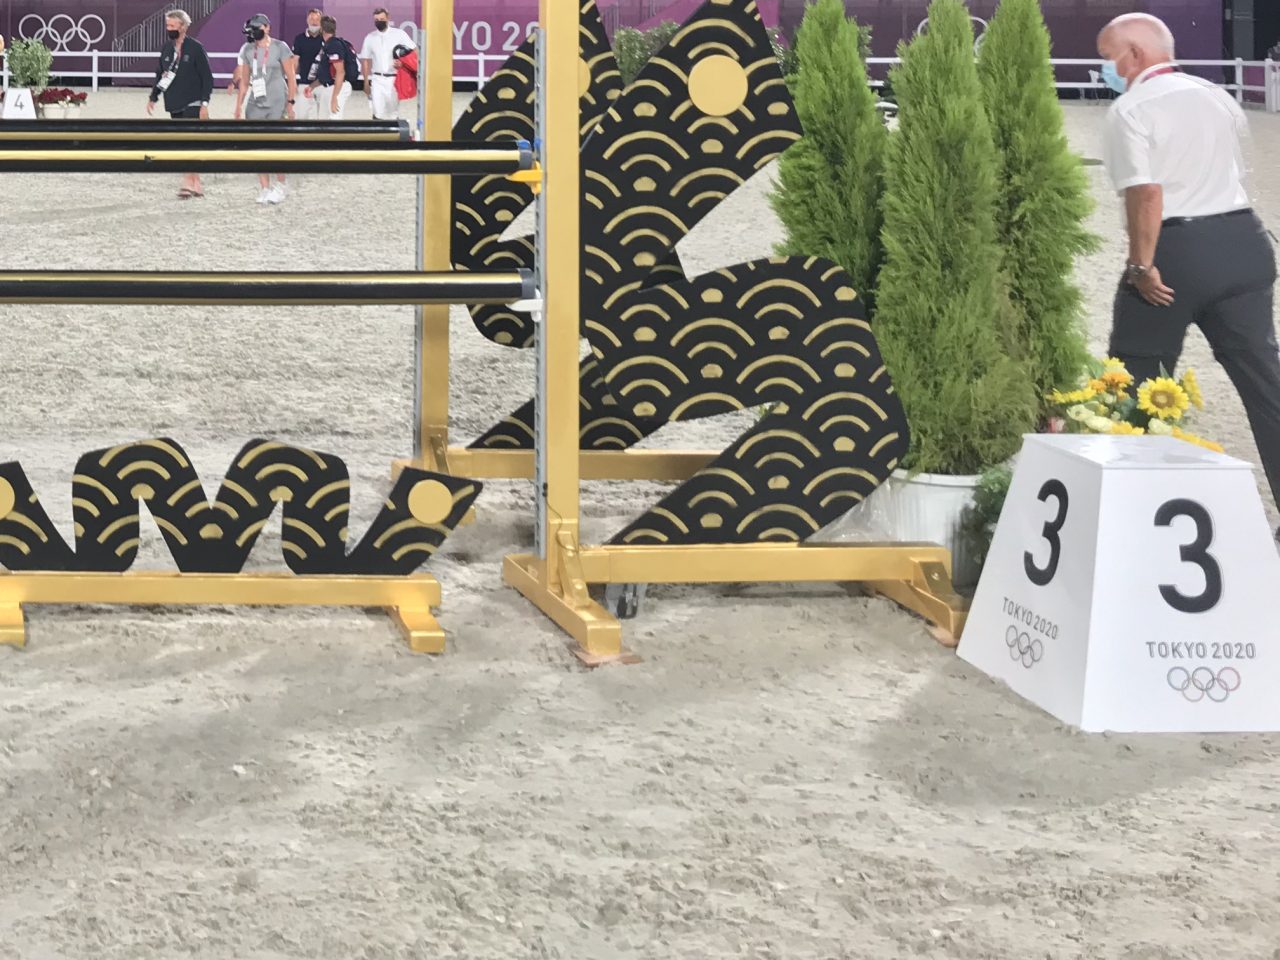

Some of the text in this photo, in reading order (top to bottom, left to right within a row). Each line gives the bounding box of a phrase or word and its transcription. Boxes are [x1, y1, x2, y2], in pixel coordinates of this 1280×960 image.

[14, 94, 25, 111] 4
[1023, 478, 1069, 587] 3
[1153, 497, 1223, 614] 3
[1002, 596, 1058, 640] TOKYO 2020
[1145, 640, 1257, 659] TOKYO 2020
